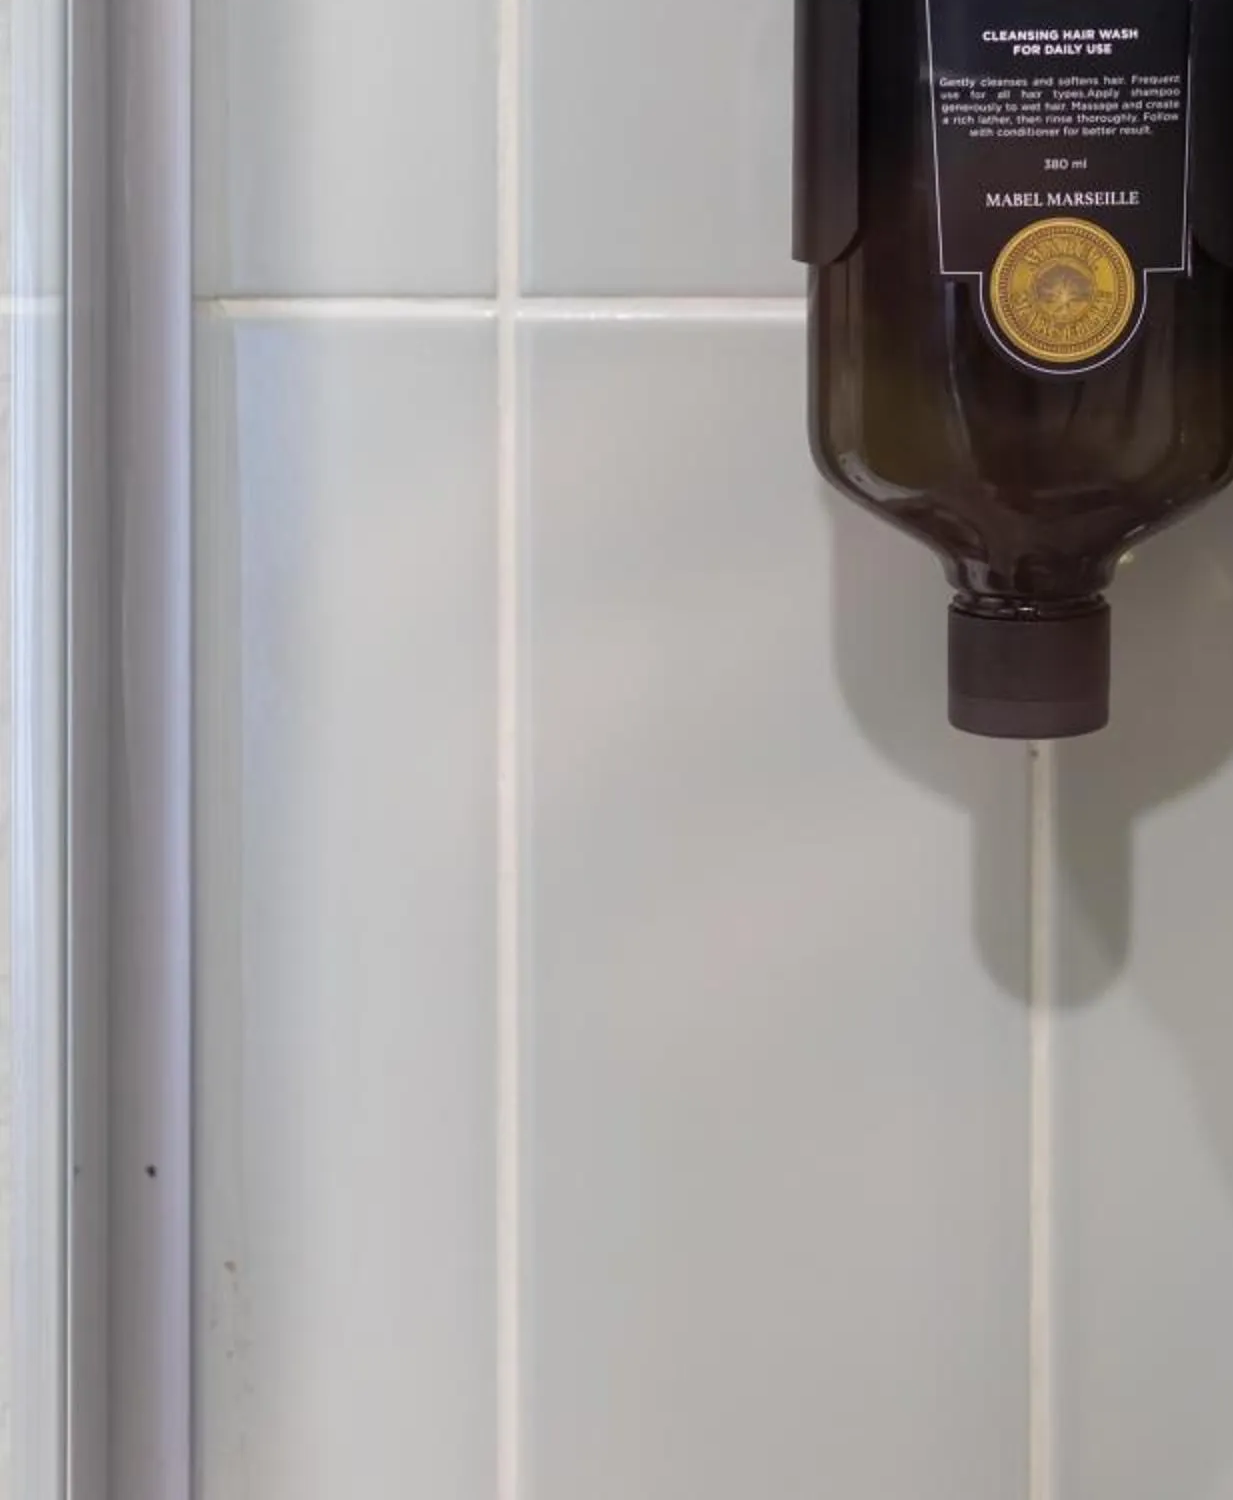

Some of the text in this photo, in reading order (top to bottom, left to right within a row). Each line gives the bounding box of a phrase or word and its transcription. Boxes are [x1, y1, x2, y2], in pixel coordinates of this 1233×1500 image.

[982, 30, 1138, 42] CLEANSING HAIR WASH
[1013, 44, 1112, 56] FOR DAILY USE
[940, 75, 1180, 88] Gently cleanses and softens hair. Frequent
[940, 91, 960, 100] use
[970, 90, 986, 99] for
[998, 89, 1011, 98] all
[1022, 89, 1042, 98] hair
[1131, 88, 1180, 98] shampoo
[942, 103, 1002, 114] generously
[1006, 102, 1018, 112] to
[1022, 102, 1042, 111] wet
[1072, 101, 1119, 112] Massage
[1122, 100, 1142, 109] and
[1146, 100, 1180, 109] create
[953, 115, 974, 124] rich
[1017, 114, 1042, 123] then
[1046, 114, 1073, 122] rinse
[1144, 112, 1178, 121] Follow
[970, 128, 994, 137] with
[997, 127, 1060, 137] conditioner
[1064, 126, 1079, 136] for
[1082, 126, 1116, 136] better
[1044, 159, 1088, 170] 380 ml
[986, 192, 1140, 207] MABEL MARSEILLE
